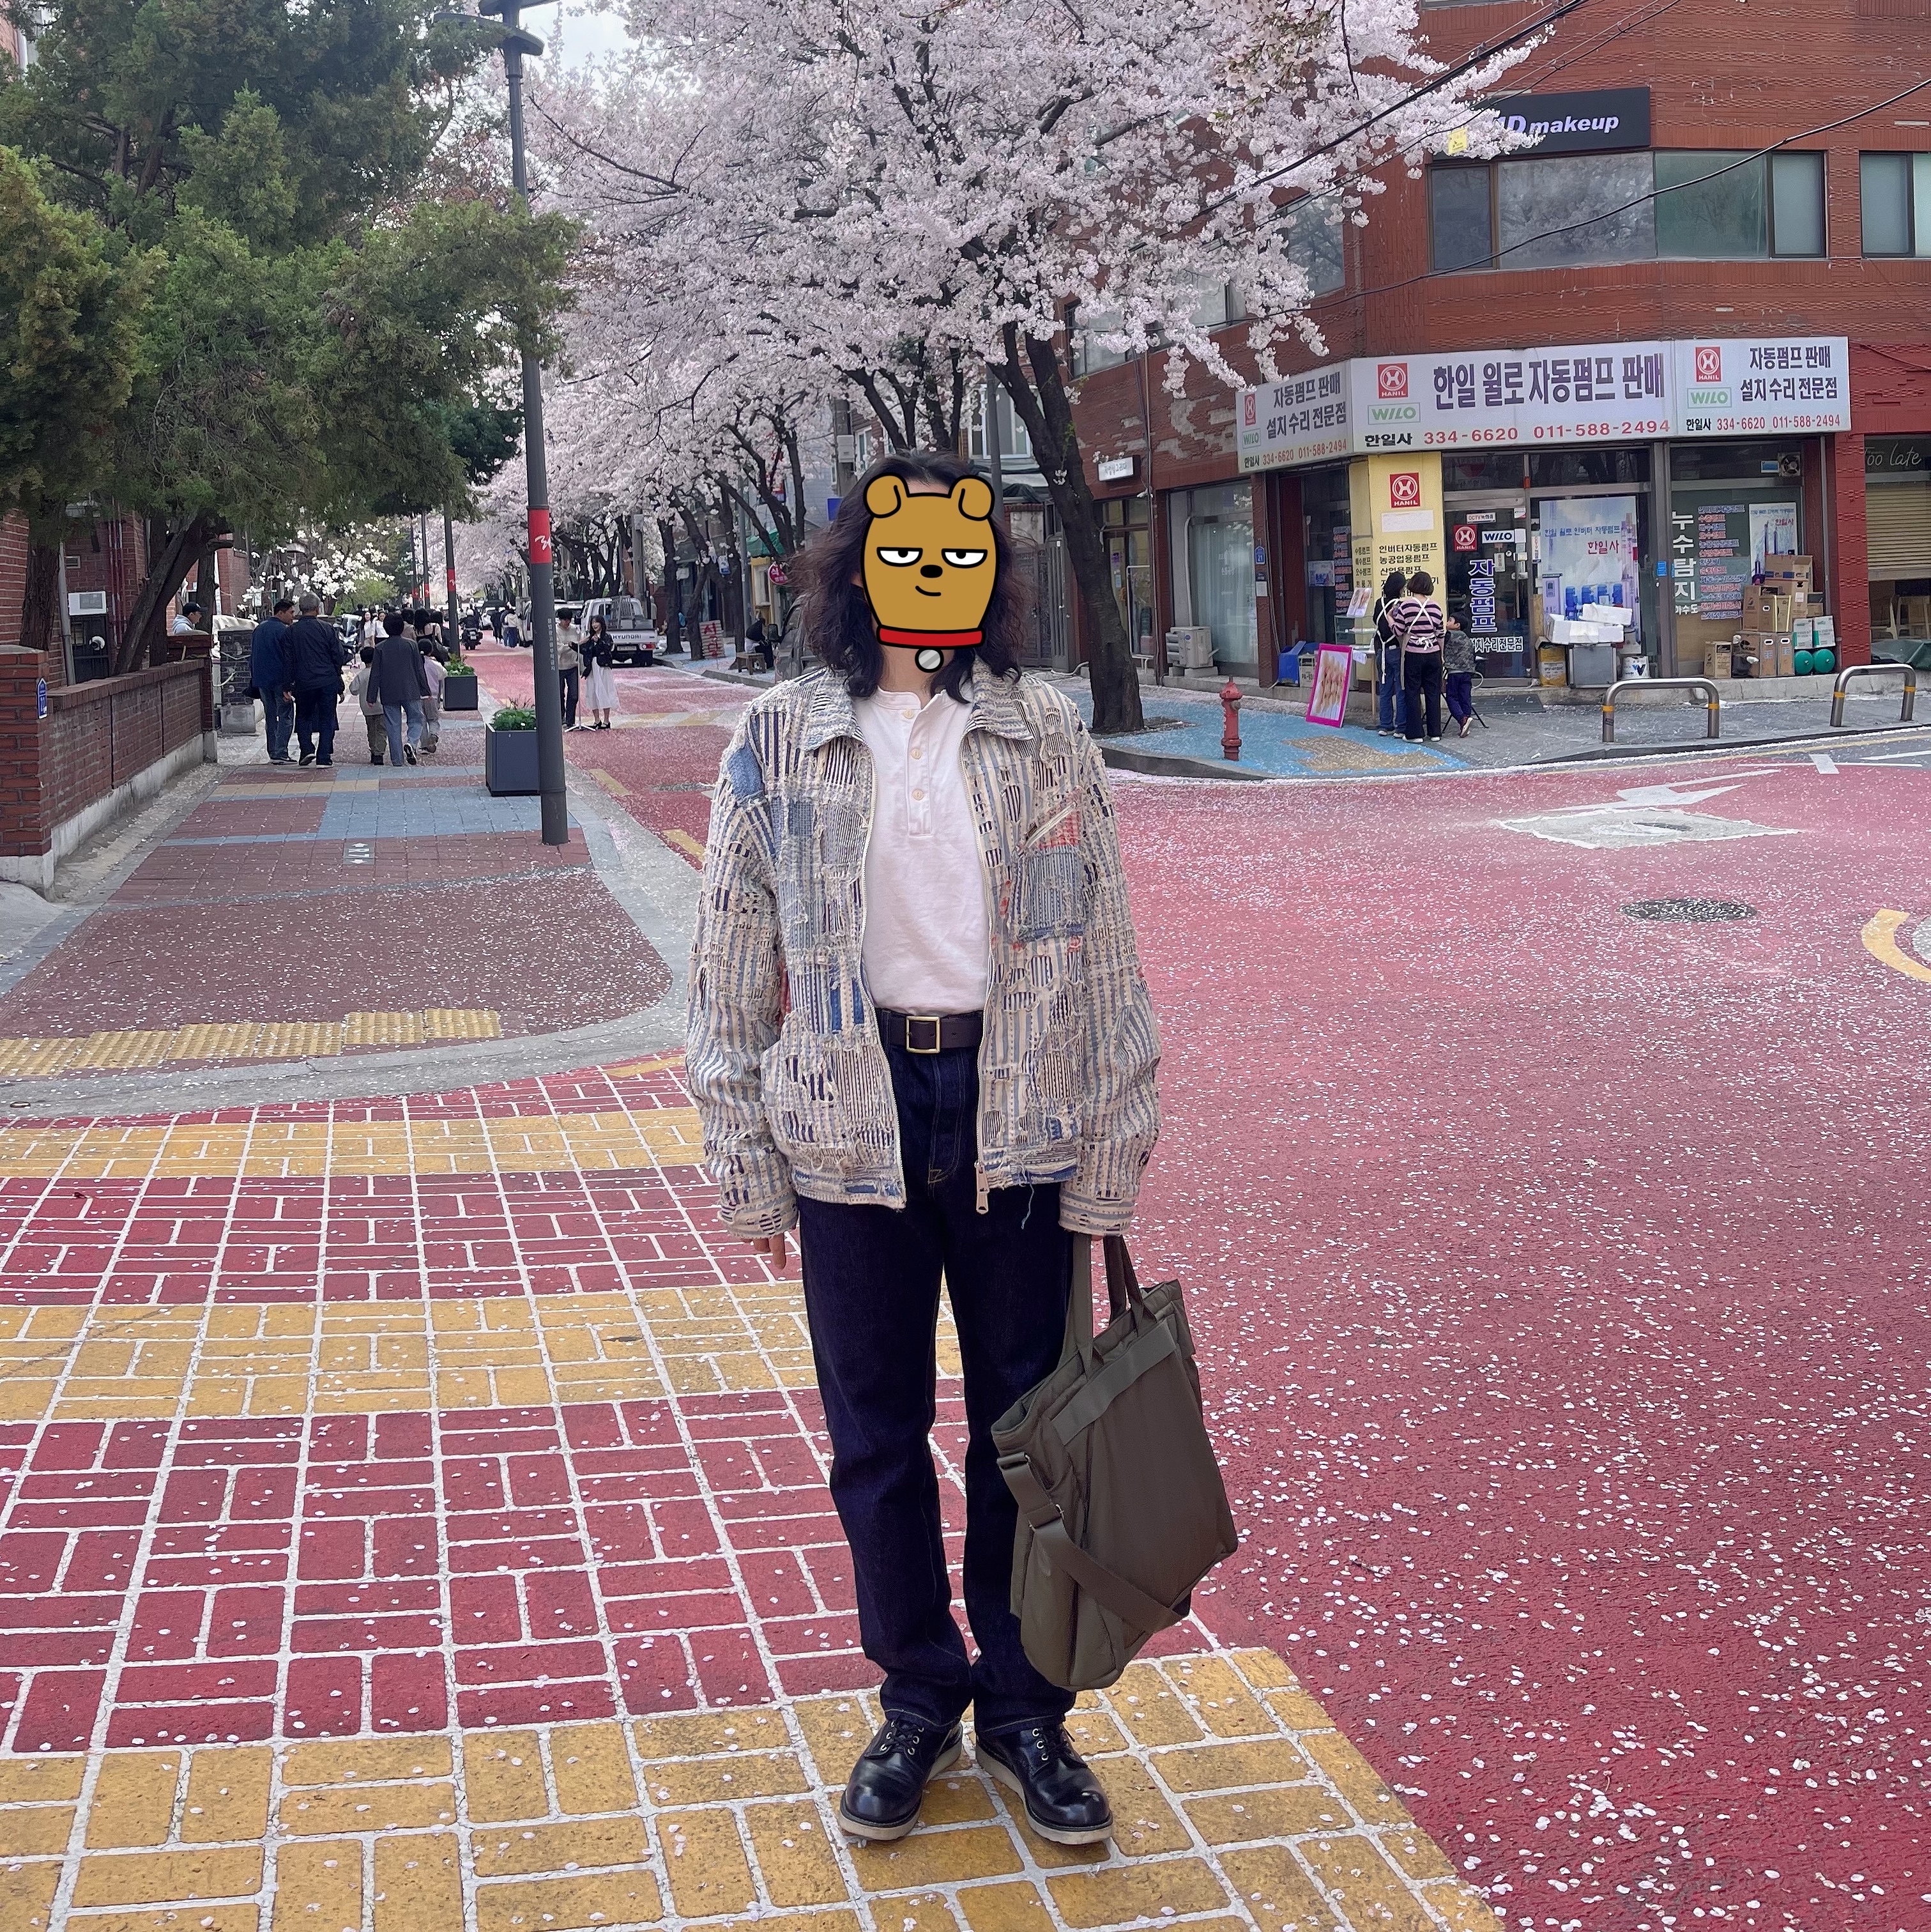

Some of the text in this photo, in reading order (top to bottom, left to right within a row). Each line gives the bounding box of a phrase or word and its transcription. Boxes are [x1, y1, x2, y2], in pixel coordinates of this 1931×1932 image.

[1529, 116, 1619, 134] makeup
[1750, 346, 1831, 370] 자동펌프 판매
[1273, 371, 1341, 409] 자동펌프 판매
[1433, 353, 1665, 410] 한일 윌로 자동펌프 판매
[1740, 376, 1838, 401] 설치 수리 전문점
[1690, 391, 1729, 404] WILO
[1267, 401, 1347, 440] 설치 수리 전문점
[1371, 406, 1417, 420] WILO
[1686, 415, 1840, 431] 한일사 334-6620 011-588-2494
[1243, 432, 1260, 446] WILO
[1364, 419, 1670, 447] 한일사 334-6620 011-588-2494
[1244, 438, 1347, 468] 한일사 334-6620 011-588-2494
[1889, 442, 1922, 466] late
[1484, 532, 1513, 540] WILO
[1574, 526, 1592, 536] 인버터
[1378, 542, 1438, 554] 인버터자동펌프
[1587, 540, 1619, 555] 한일사
[1672, 511, 1697, 601] 누수탐지
[1467, 558, 1498, 633] 자동펌프
